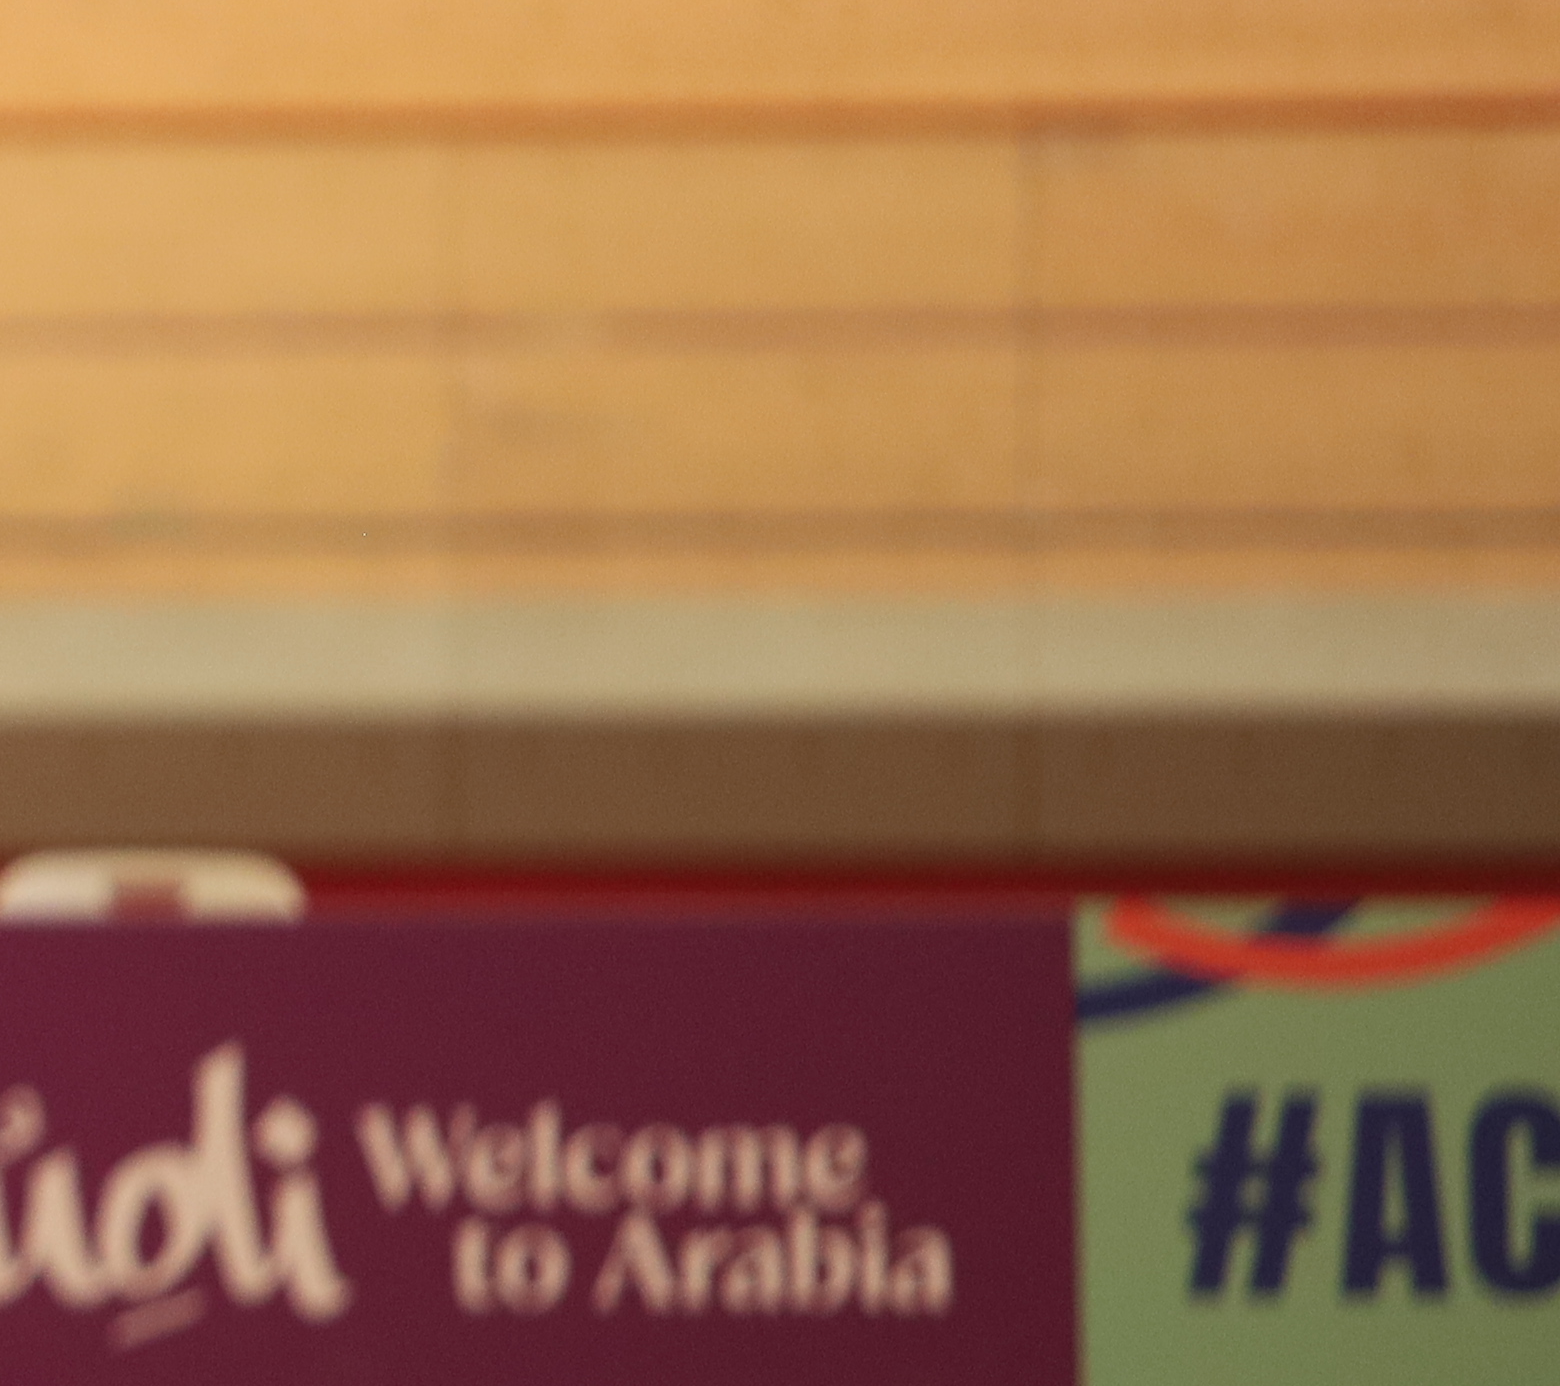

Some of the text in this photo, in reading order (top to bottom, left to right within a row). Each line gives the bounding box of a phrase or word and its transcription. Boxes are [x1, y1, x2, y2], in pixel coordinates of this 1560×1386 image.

[356, 1099, 870, 1211] Welcome
[1183, 1083, 1560, 1308] #AC
[450, 1200, 954, 1319] to Arabia
